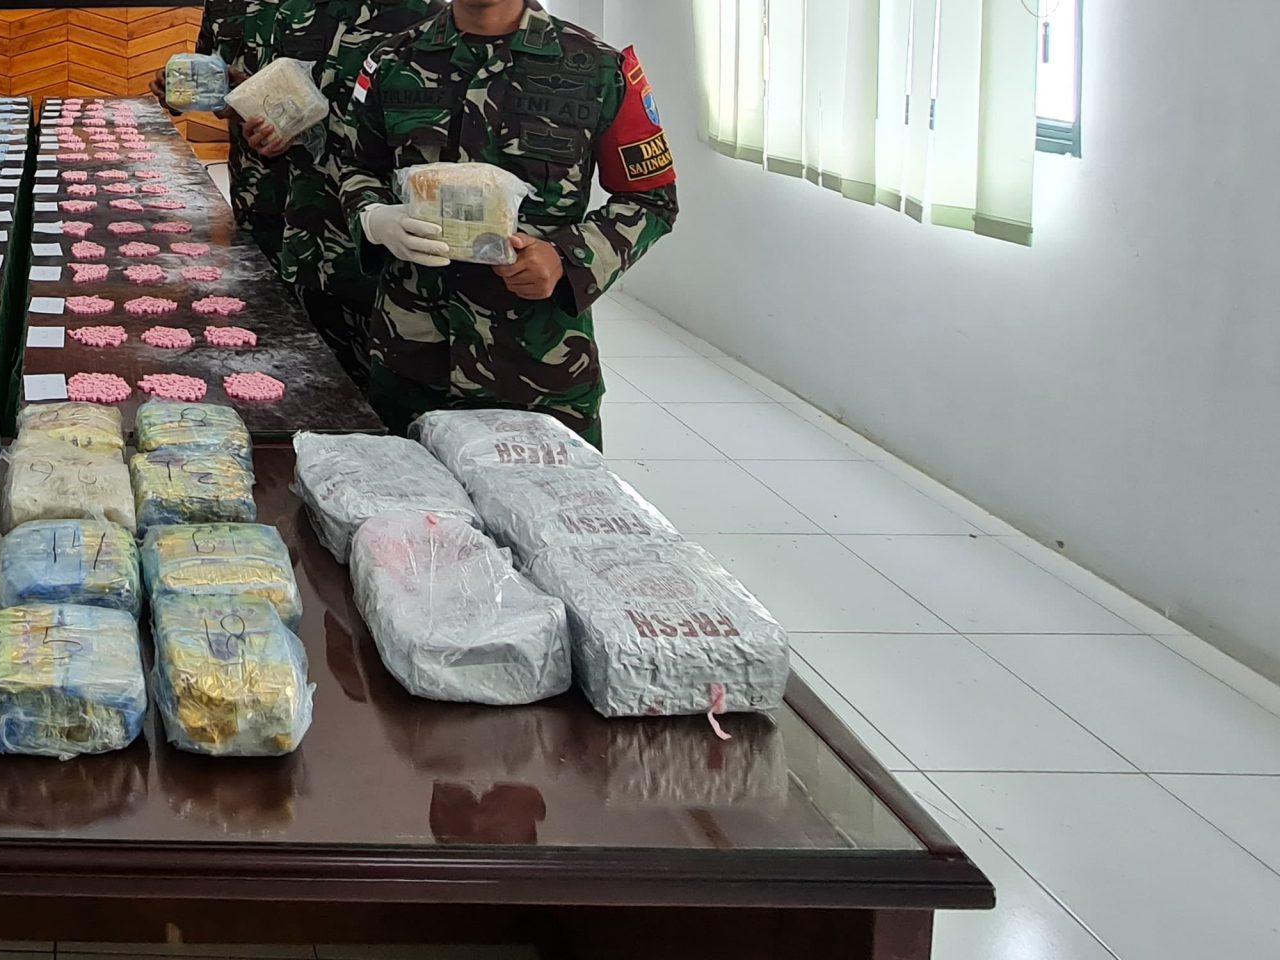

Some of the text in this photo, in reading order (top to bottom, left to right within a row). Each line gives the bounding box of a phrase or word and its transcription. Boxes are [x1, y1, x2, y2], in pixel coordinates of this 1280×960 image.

[514, 96, 591, 120] TNI AD
[640, 135, 665, 160] DAN
[494, 441, 569, 466] FRESH
[557, 512, 651, 536] FRESH
[203, 613, 246, 656] 18
[623, 609, 741, 638] FRESH
